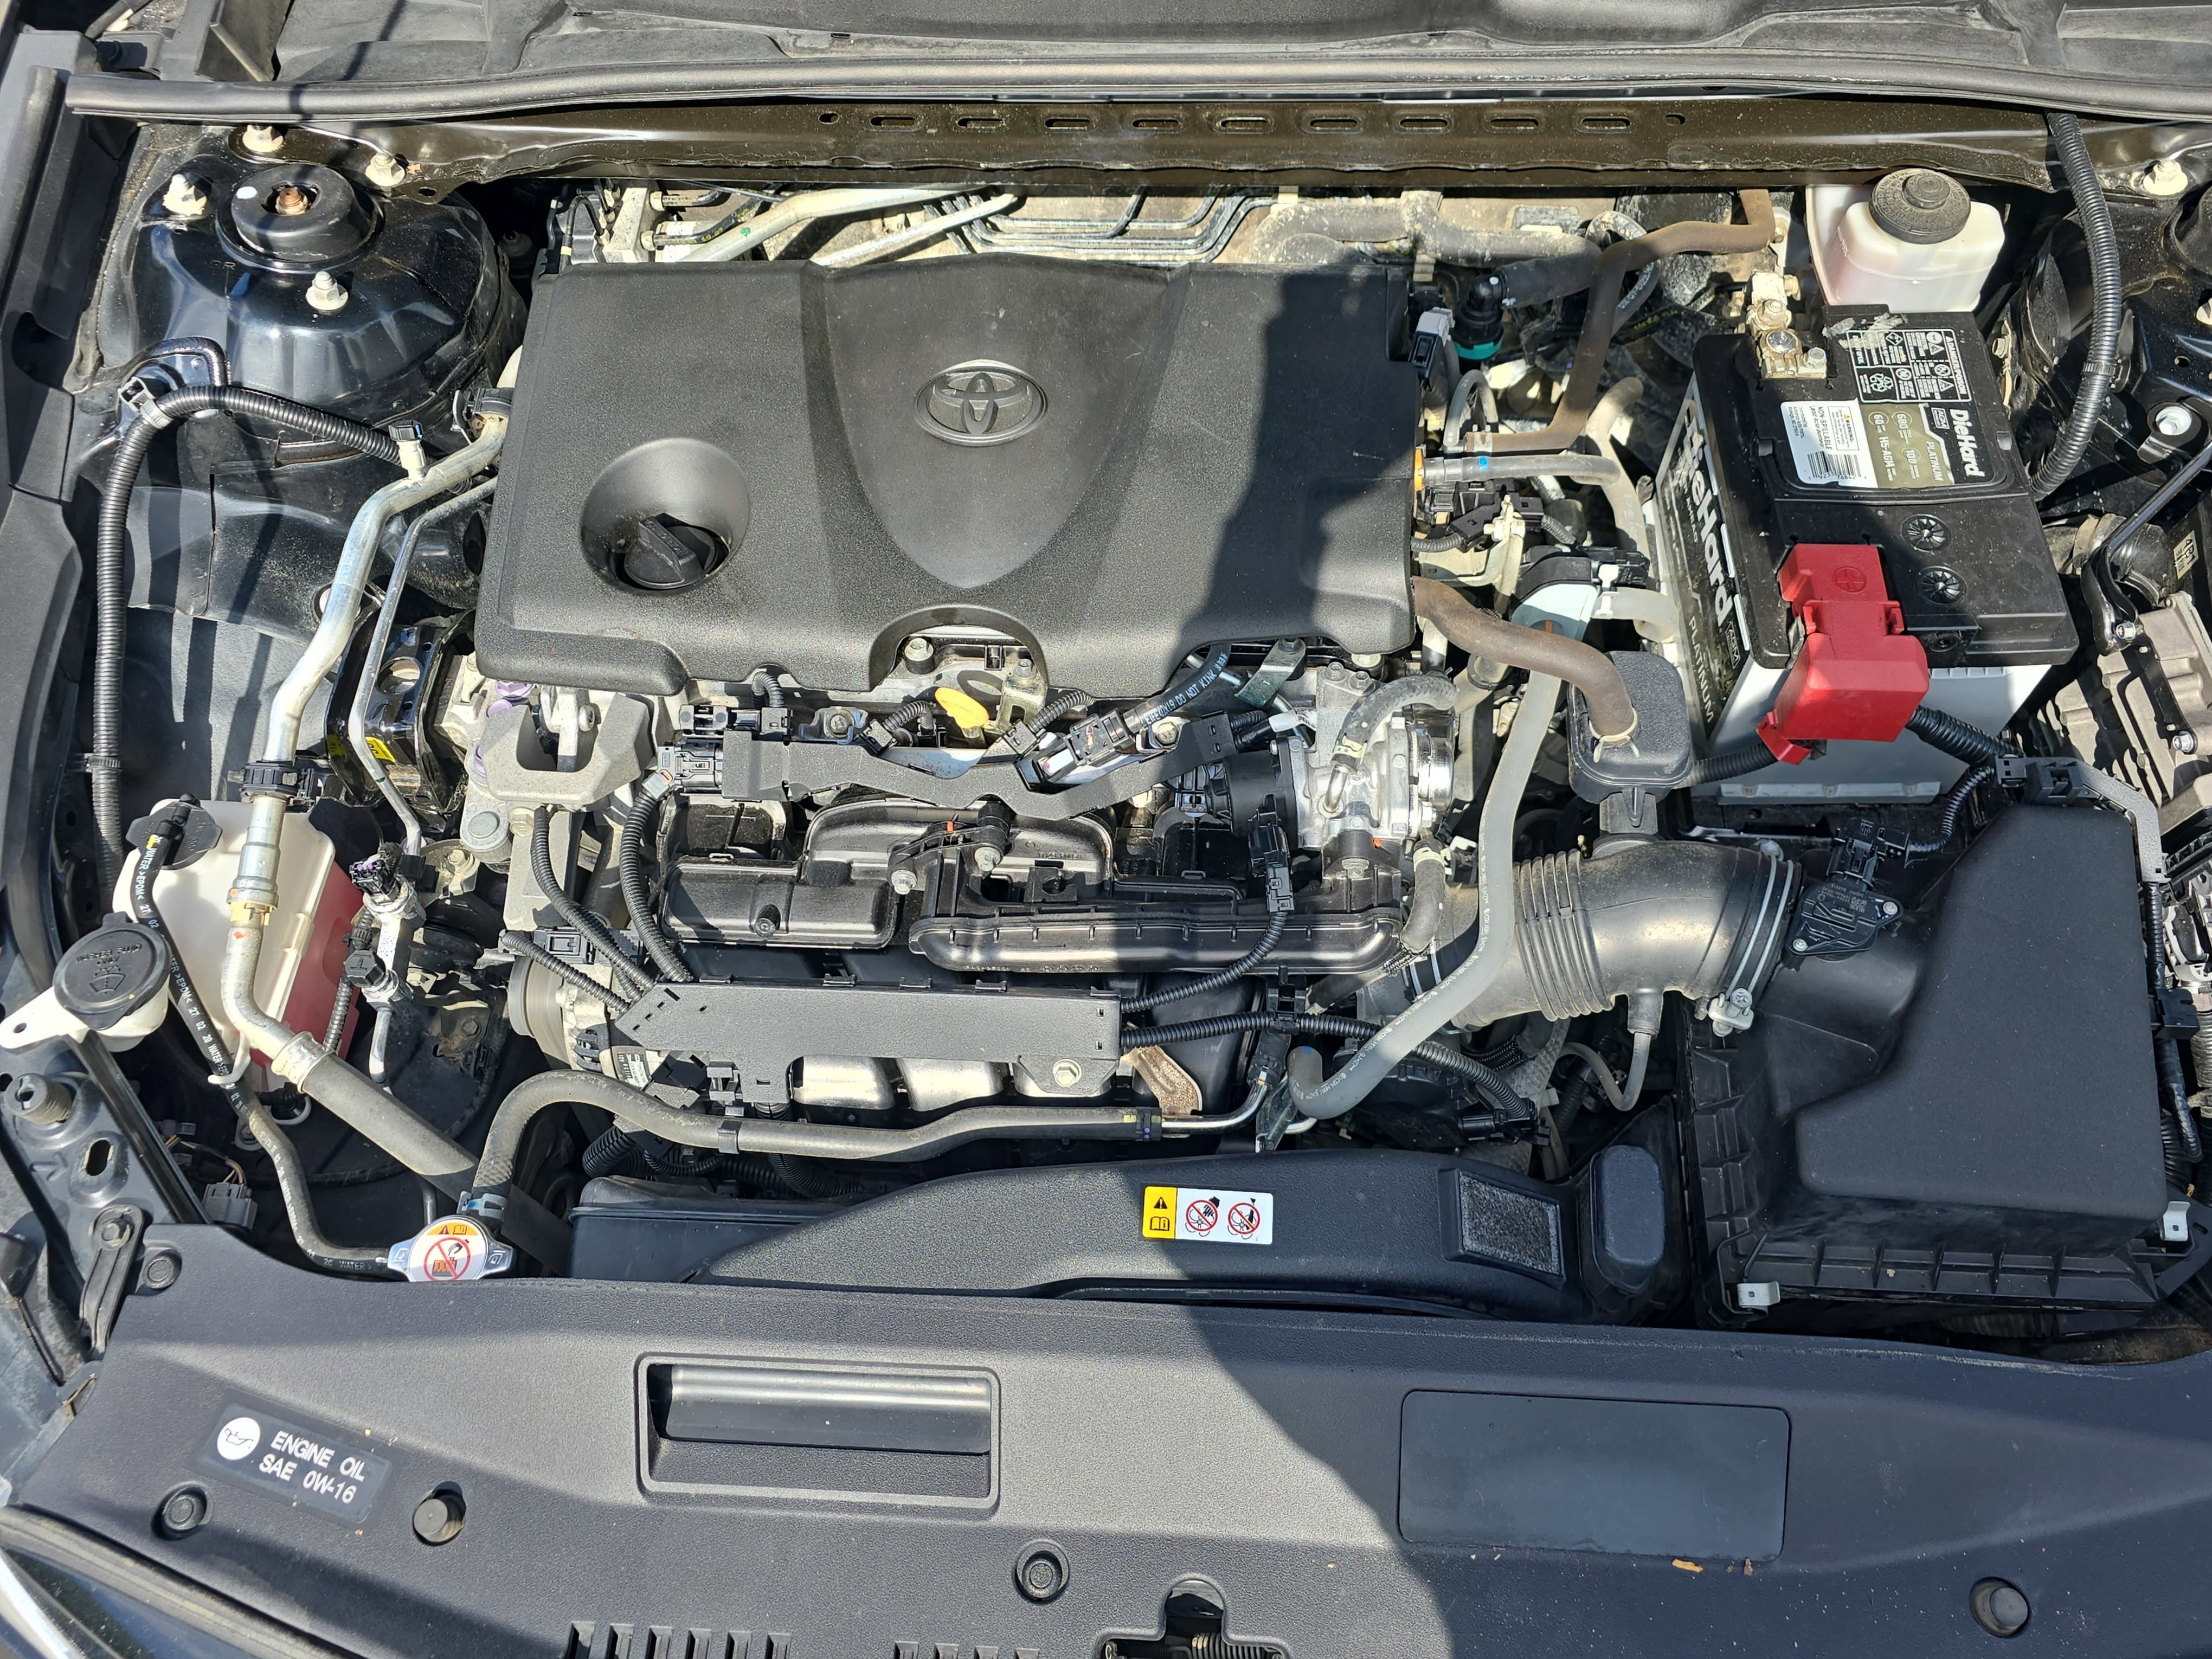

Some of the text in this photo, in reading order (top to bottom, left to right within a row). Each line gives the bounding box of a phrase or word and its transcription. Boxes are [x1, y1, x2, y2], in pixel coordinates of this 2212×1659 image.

[1810, 406, 1818, 417] Lead
[1873, 414, 1885, 425] 60
[1897, 413, 1908, 429] 680
[1939, 409, 1947, 428] AGM
[1817, 406, 1832, 450] NON-SPILLABLE
[1879, 436, 1895, 468] H5-AGM
[1950, 409, 1985, 477] DieHard
[1905, 449, 1916, 464] 100
[1926, 441, 1944, 481] PLATINUM
[1688, 615, 1714, 723] PLATINUM
[1187, 683, 1200, 700] NOT
[1200, 670, 1218, 690] KINK
[140, 847, 157, 870] WATER
[148, 919, 159, 929] 02
[75, 949, 113, 963] WASHER
[188, 1006, 198, 1017] 27
[195, 1021, 207, 1031] 02
[202, 1034, 213, 1045] 20
[207, 1044, 223, 1064] WATER
[270, 1430, 365, 1482] ENGINE OIL
[259, 1454, 357, 1504] SAE 0W-16
